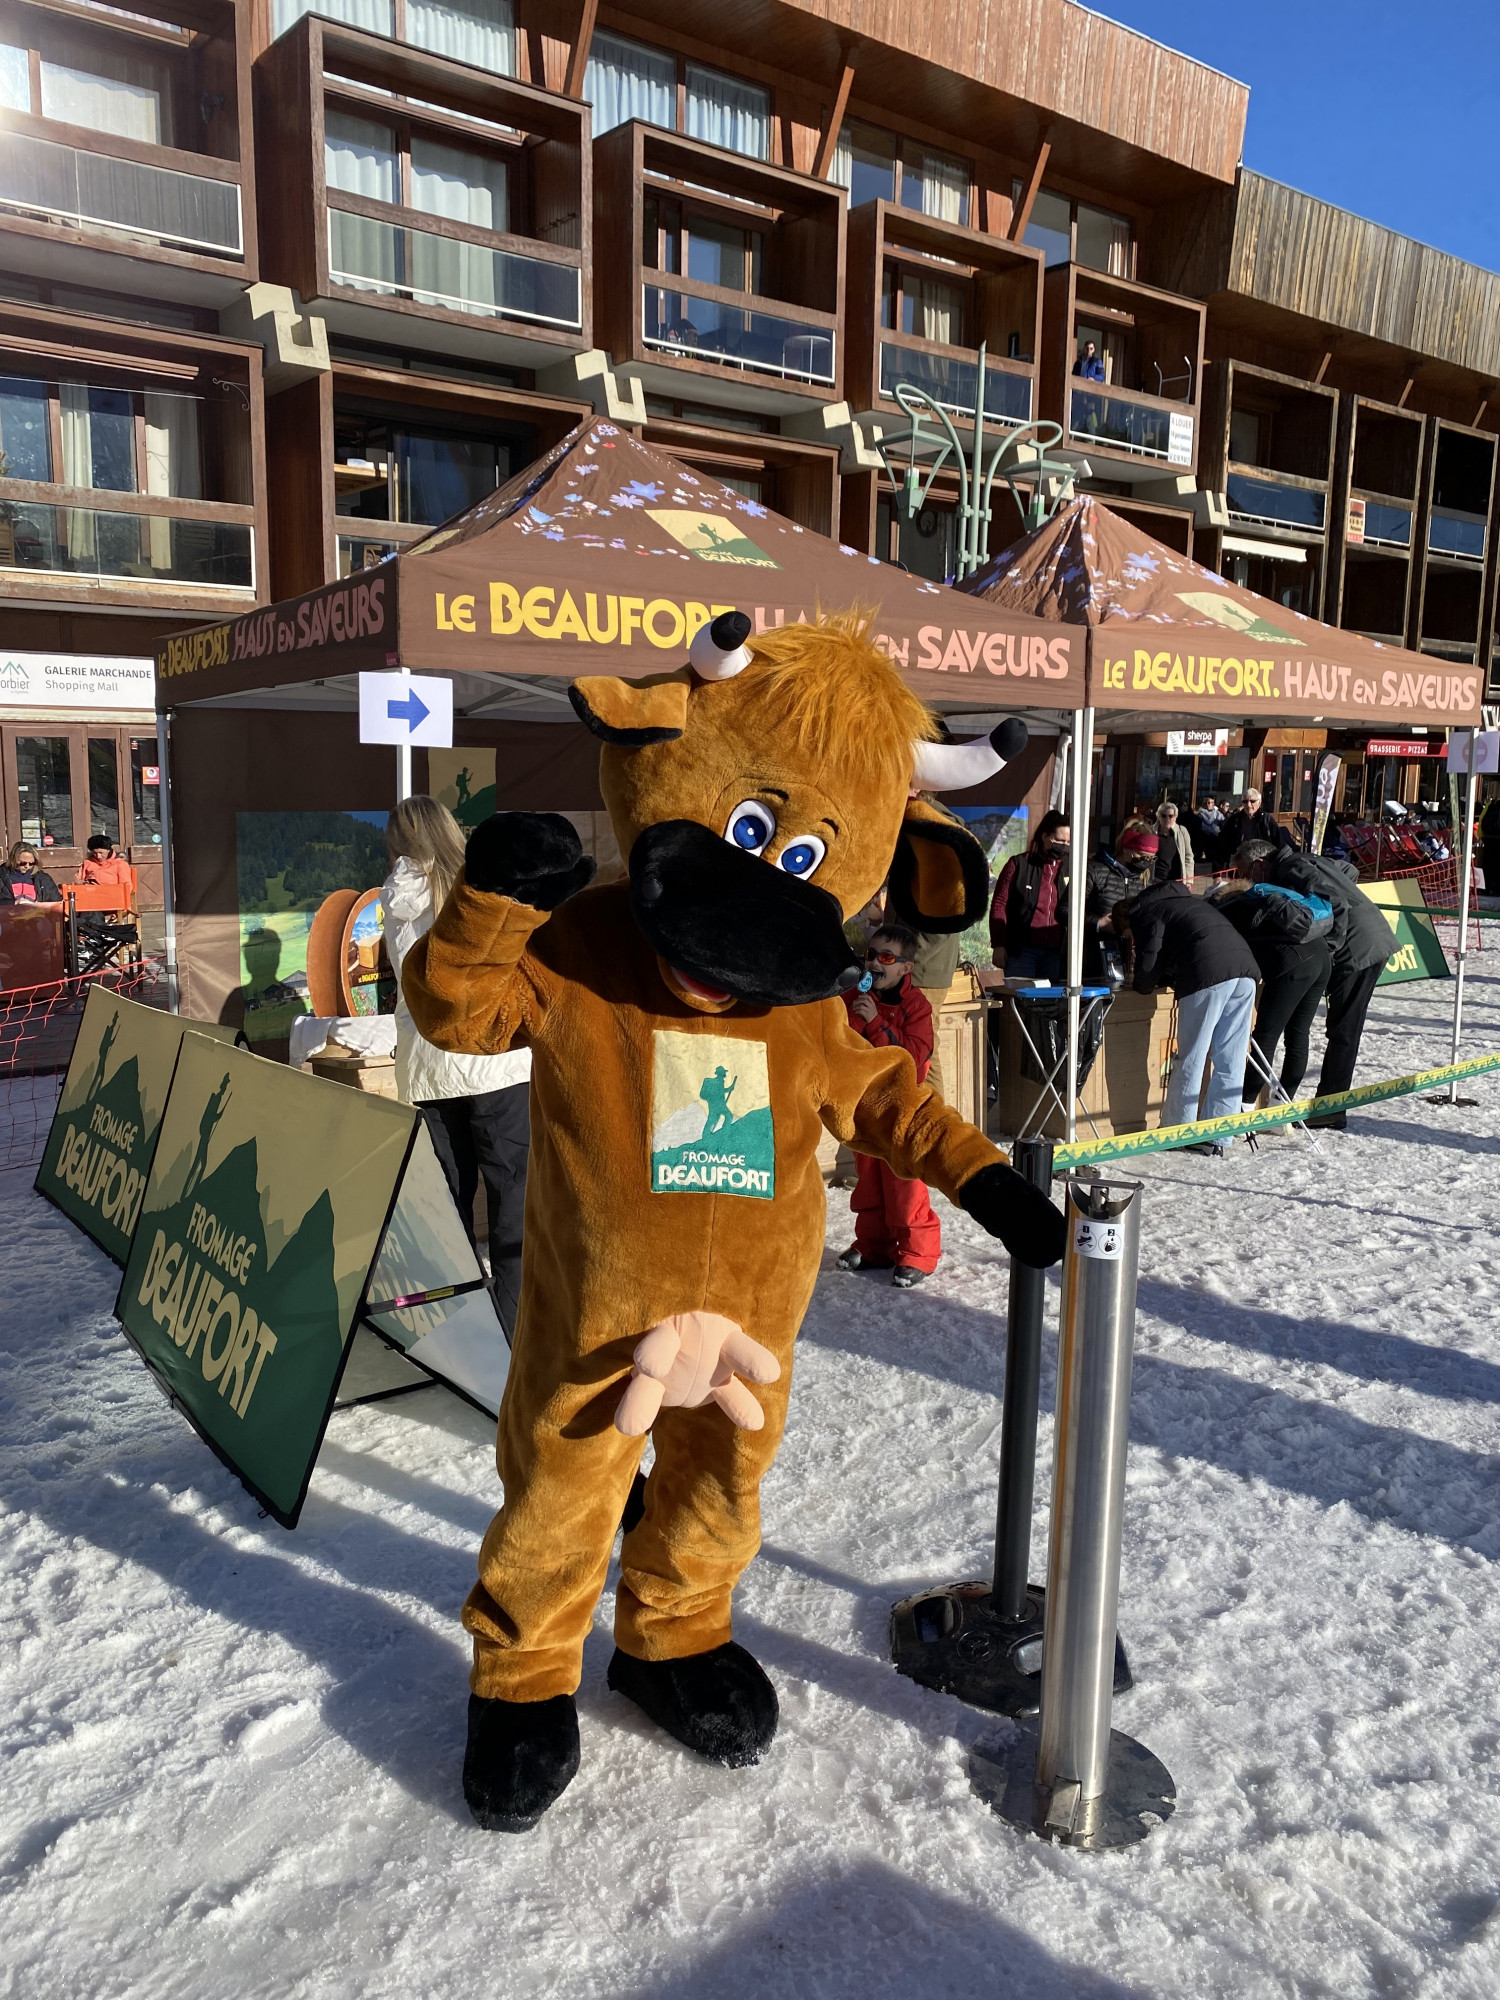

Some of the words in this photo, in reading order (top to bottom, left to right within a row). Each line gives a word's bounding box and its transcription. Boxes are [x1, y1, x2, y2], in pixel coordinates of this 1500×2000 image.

[231, 611, 277, 661] HAUT
[296, 578, 385, 649] SAVEURS
[435, 592, 476, 632] LE
[917, 625, 1071, 679] SAVEURS
[1, 677, 30, 690] orbier
[45, 665, 87, 676] GALERIE
[90, 668, 152, 679] MARCHANDE
[45, 680, 95, 692] Shopping
[98, 681, 119, 691] Mall
[1103, 659, 1126, 689] LE
[1284, 660, 1351, 702] HAUT
[1380, 670, 1477, 711] SAVEURS
[1187, 729, 1212, 742] sherpa
[1370, 744, 1401, 753] BRASSERIE
[1408, 745, 1428, 754] PIZZAS
[90, 1103, 138, 1154] FROMAGE
[682, 1151, 746, 1166] FROMAGE
[658, 1164, 770, 1191] BEAUFORT
[186, 1202, 257, 1286] FROMAGE
[138, 1229, 278, 1420] BEAUFORT
